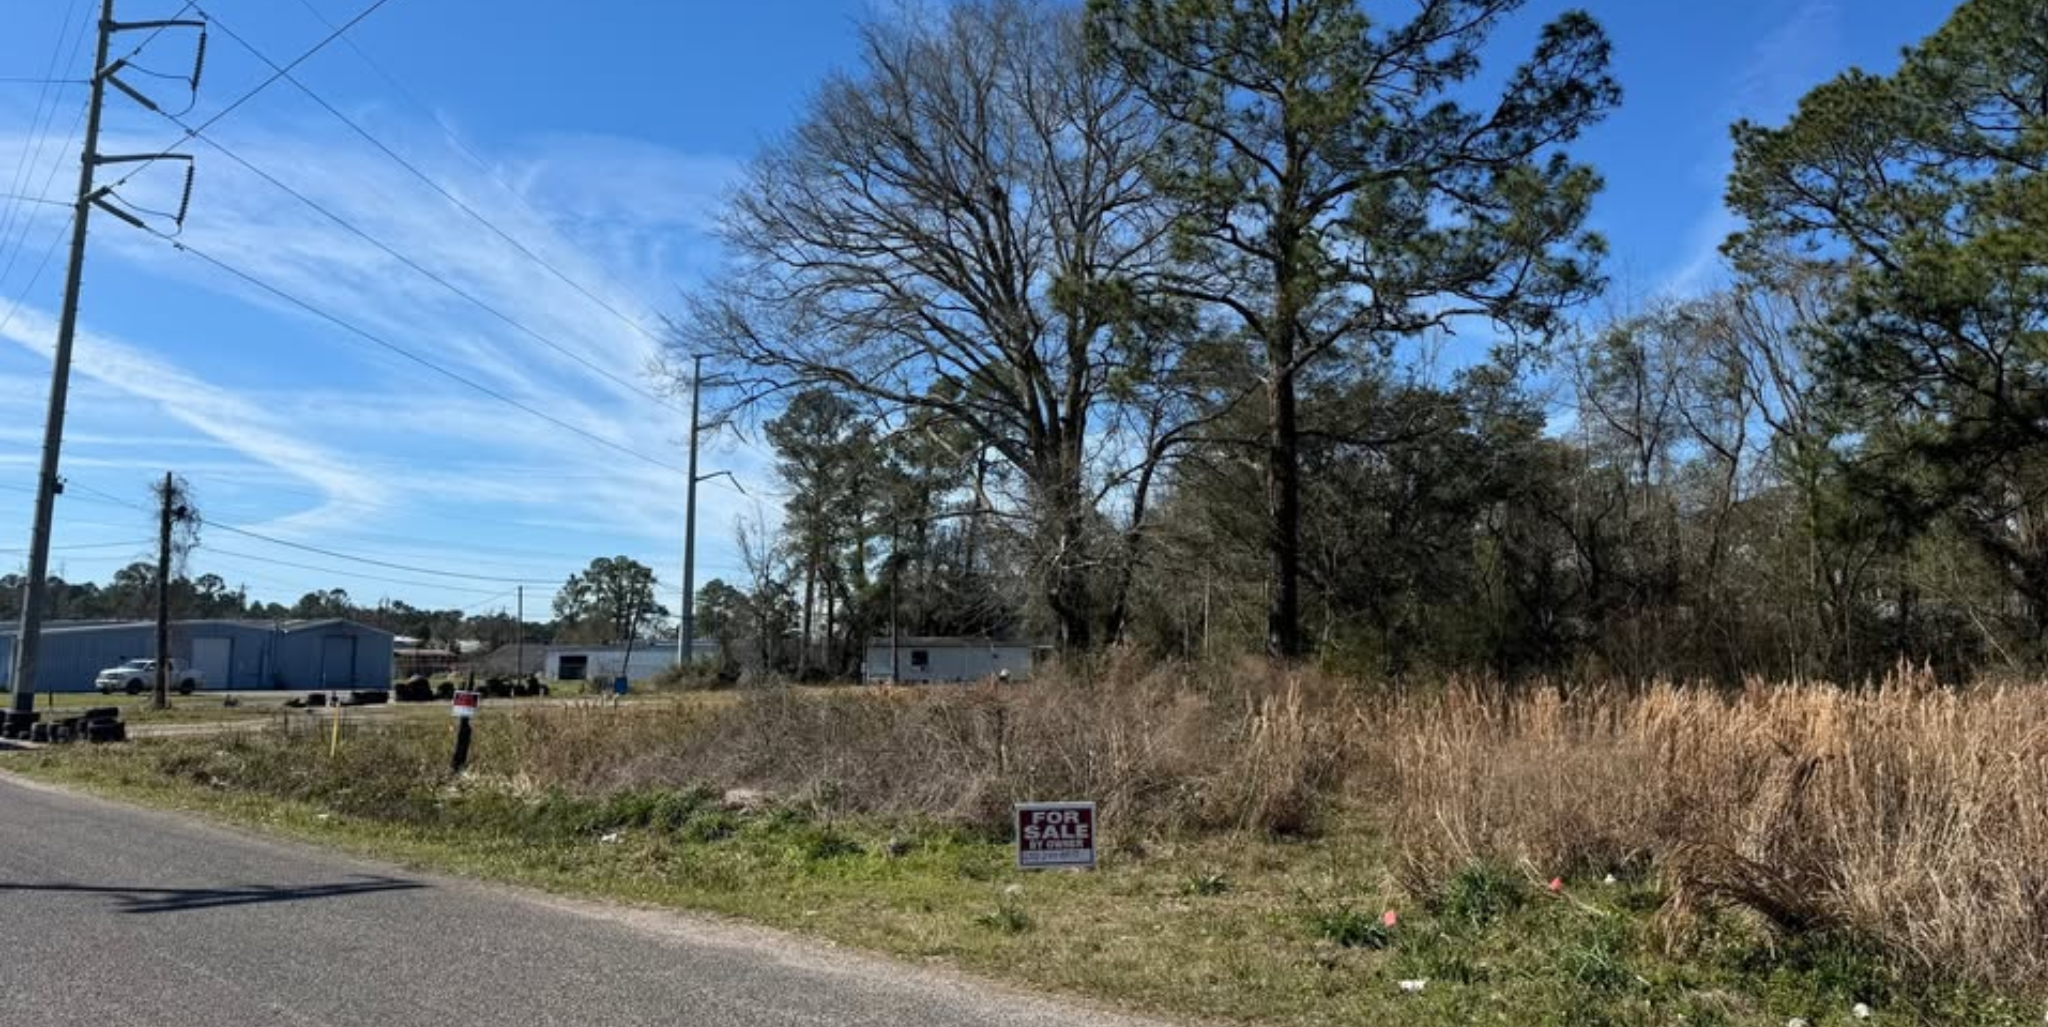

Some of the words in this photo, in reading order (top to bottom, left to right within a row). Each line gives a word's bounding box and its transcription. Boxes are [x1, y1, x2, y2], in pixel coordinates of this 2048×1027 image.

[1032, 811, 1079, 824] FOR
[1024, 824, 1089, 839] SALE
[1029, 839, 1043, 850] BY
[1046, 839, 1083, 849] OWNER
